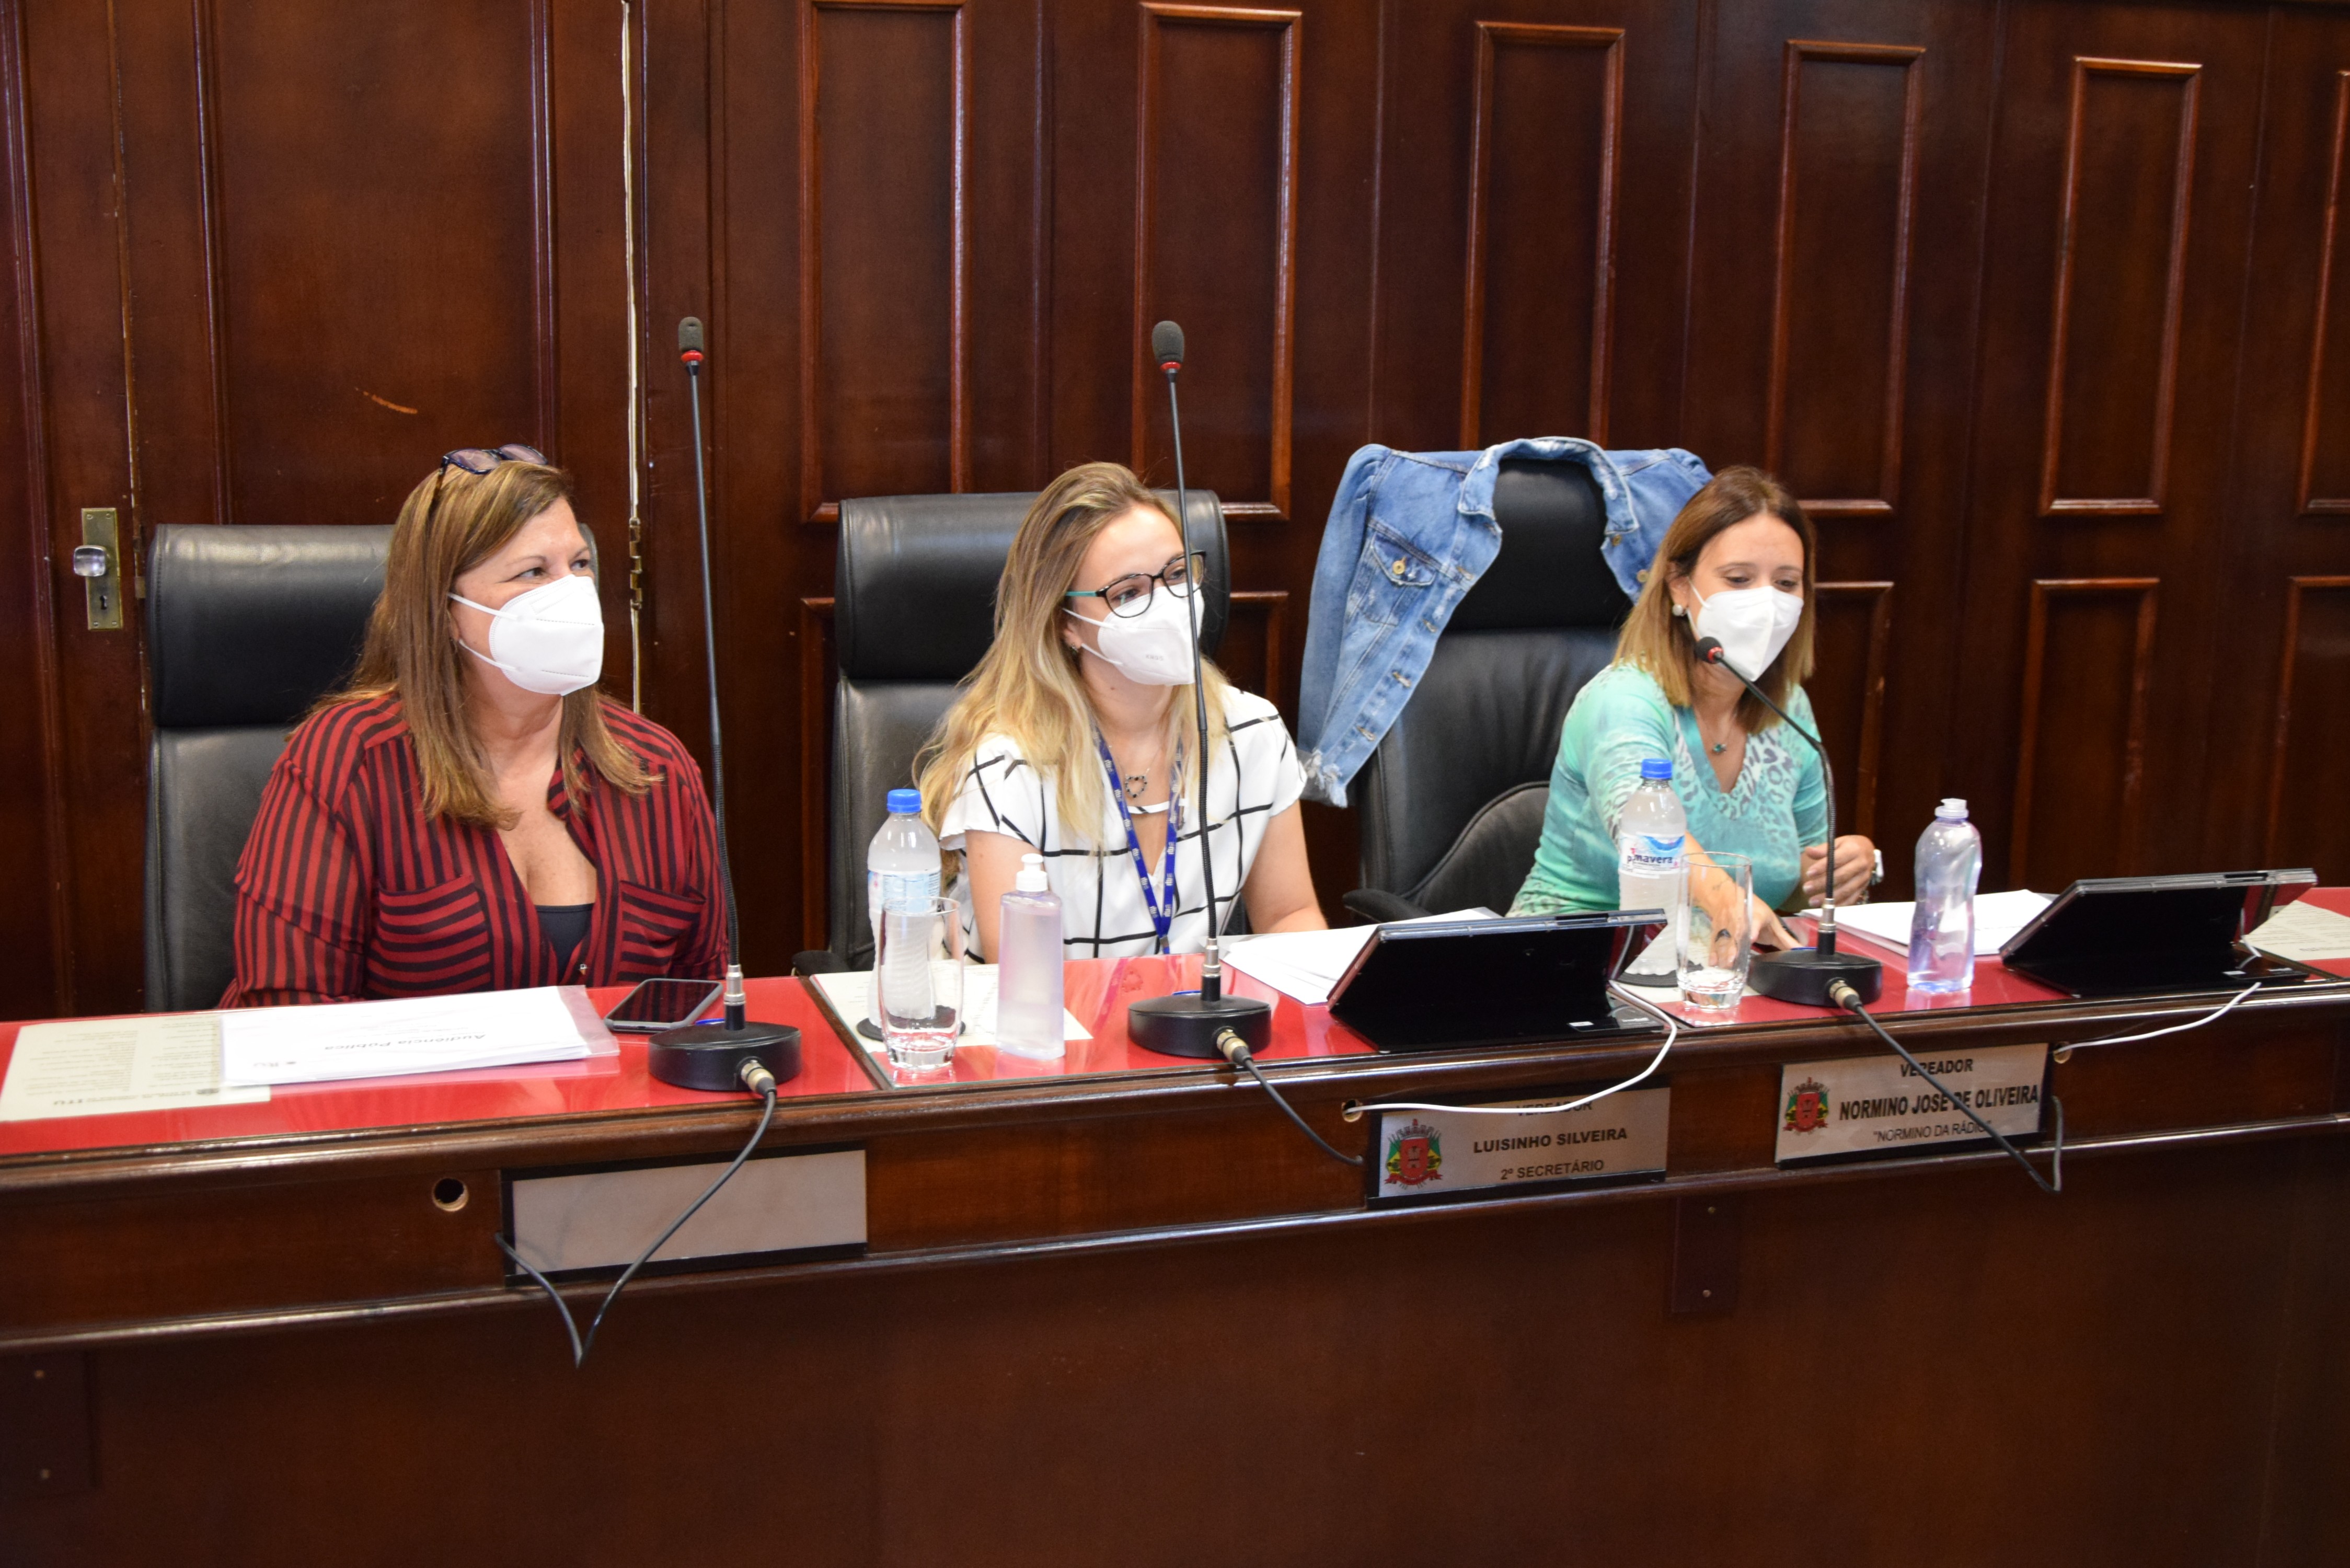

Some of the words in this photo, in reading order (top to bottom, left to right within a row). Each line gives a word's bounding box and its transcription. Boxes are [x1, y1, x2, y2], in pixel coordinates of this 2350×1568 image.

[325, 1041, 391, 1050] Pública
[398, 1034, 486, 1044] Audiência
[1839, 1096, 1908, 1121] NORMINO
[1975, 1085, 2038, 1108] OLIVEIRA
[1473, 1135, 1551, 1154] LUISINHO
[1557, 1128, 1628, 1146] SILVEIRA
[1873, 1126, 1931, 1142] "NORMINO
[1934, 1124, 1949, 1137] DA
[1501, 1168, 1514, 1180] 2º
[1517, 1159, 1604, 1179] SECRETÁRIO
